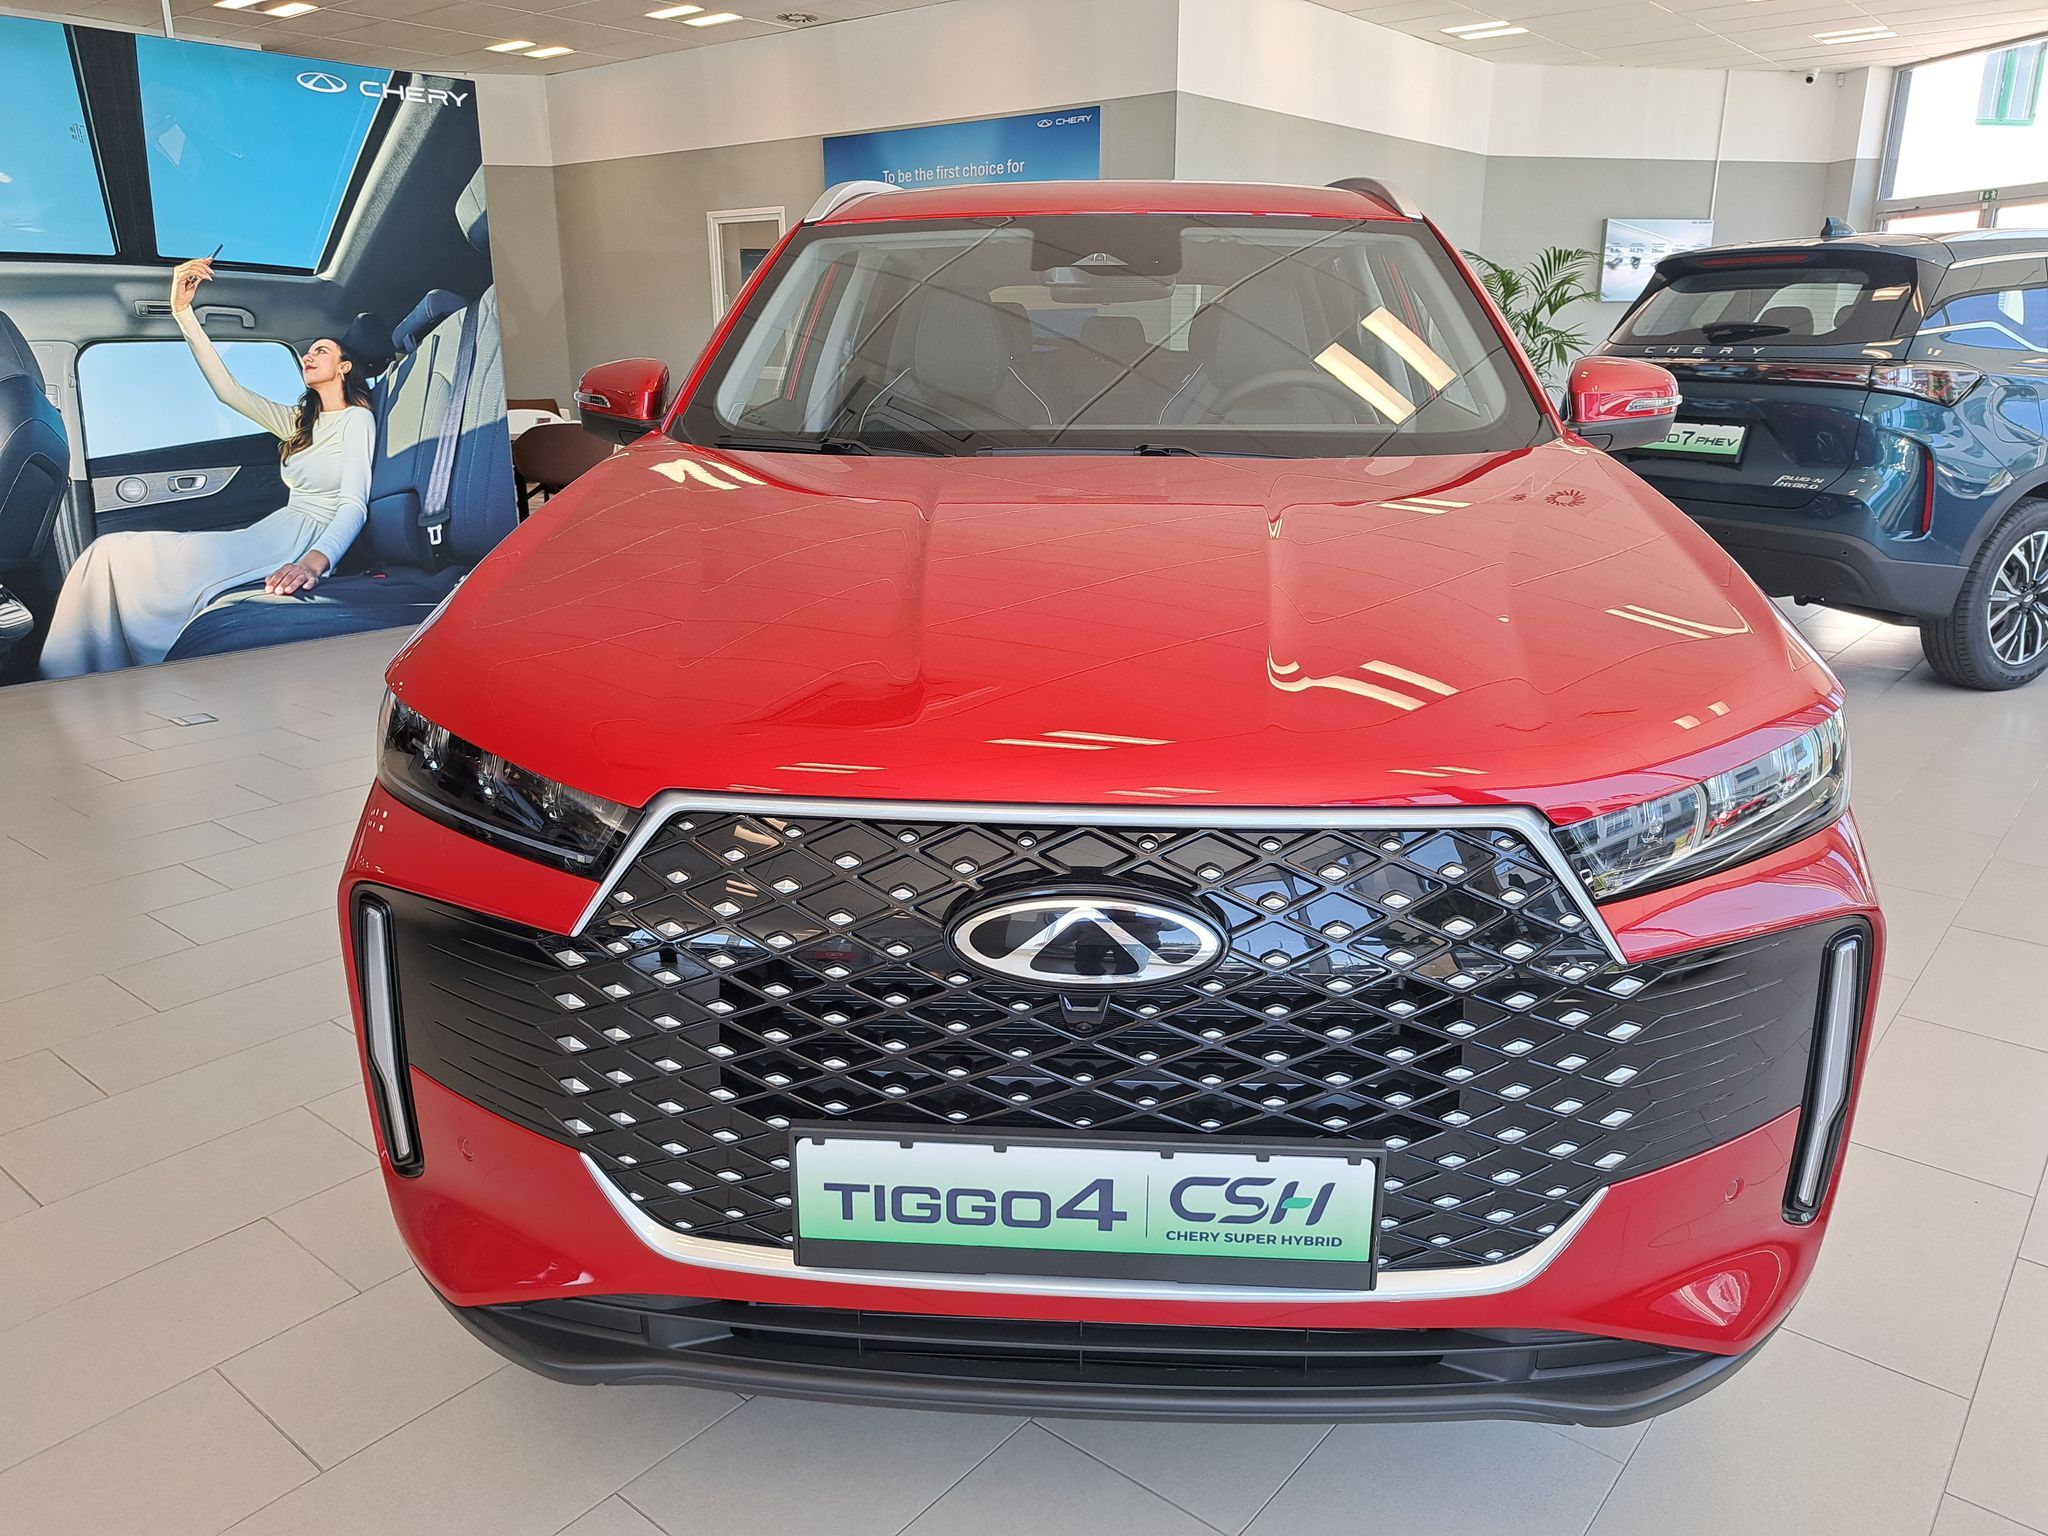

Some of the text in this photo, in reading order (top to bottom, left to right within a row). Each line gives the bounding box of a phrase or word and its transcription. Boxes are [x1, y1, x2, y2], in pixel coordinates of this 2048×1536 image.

[359, 80, 469, 108] CHERY
[1055, 114, 1093, 126] CHERY
[882, 159, 1025, 184] To be the first choice for
[1644, 346, 1765, 355] CHERY
[1694, 436, 1739, 447] PHEV
[1169, 1176, 1337, 1226] CSH
[1165, 1230, 1343, 1248] CHERY SUPER HYBRID
